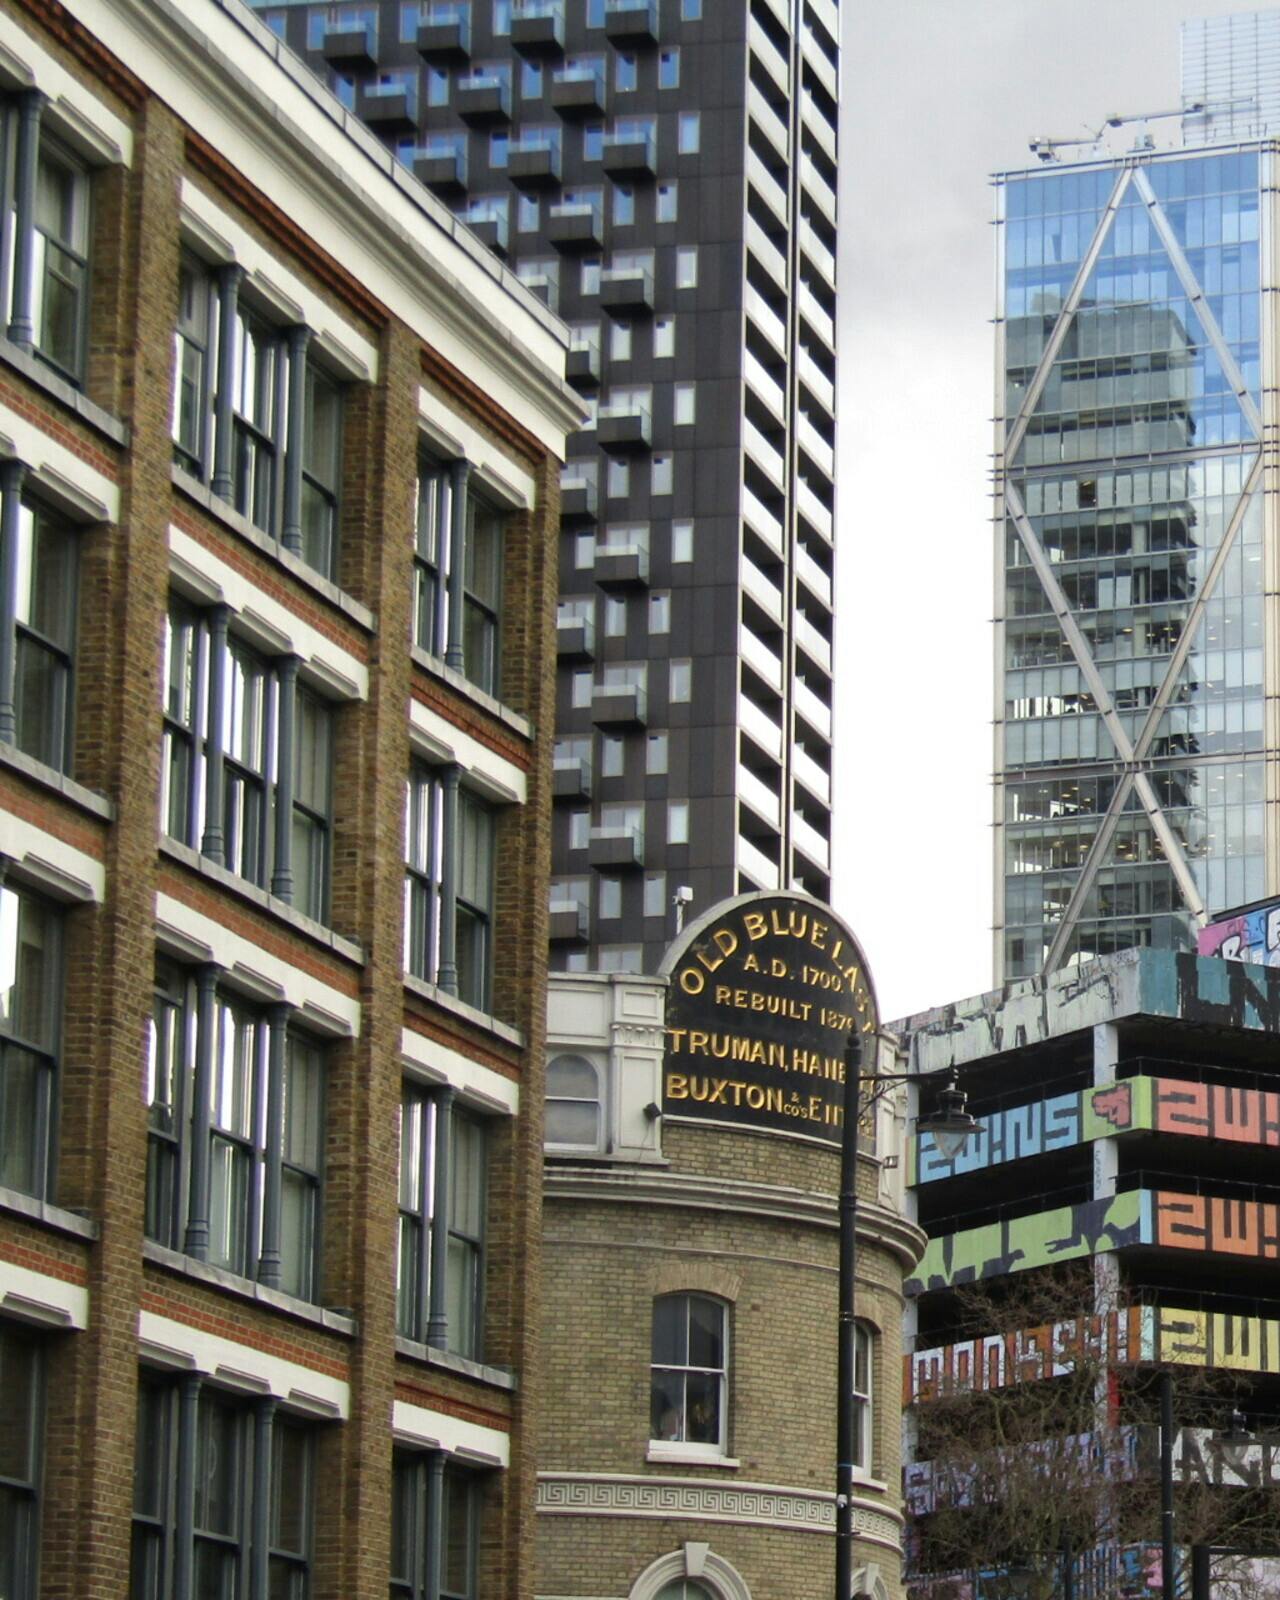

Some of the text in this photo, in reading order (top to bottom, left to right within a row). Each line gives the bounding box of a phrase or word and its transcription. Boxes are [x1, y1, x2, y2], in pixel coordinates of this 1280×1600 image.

[680, 928, 738, 995] OLD
[743, 909, 829, 950] BLUE
[715, 985, 812, 1021] REBUILT
[666, 1073, 783, 1113] BUXTON
